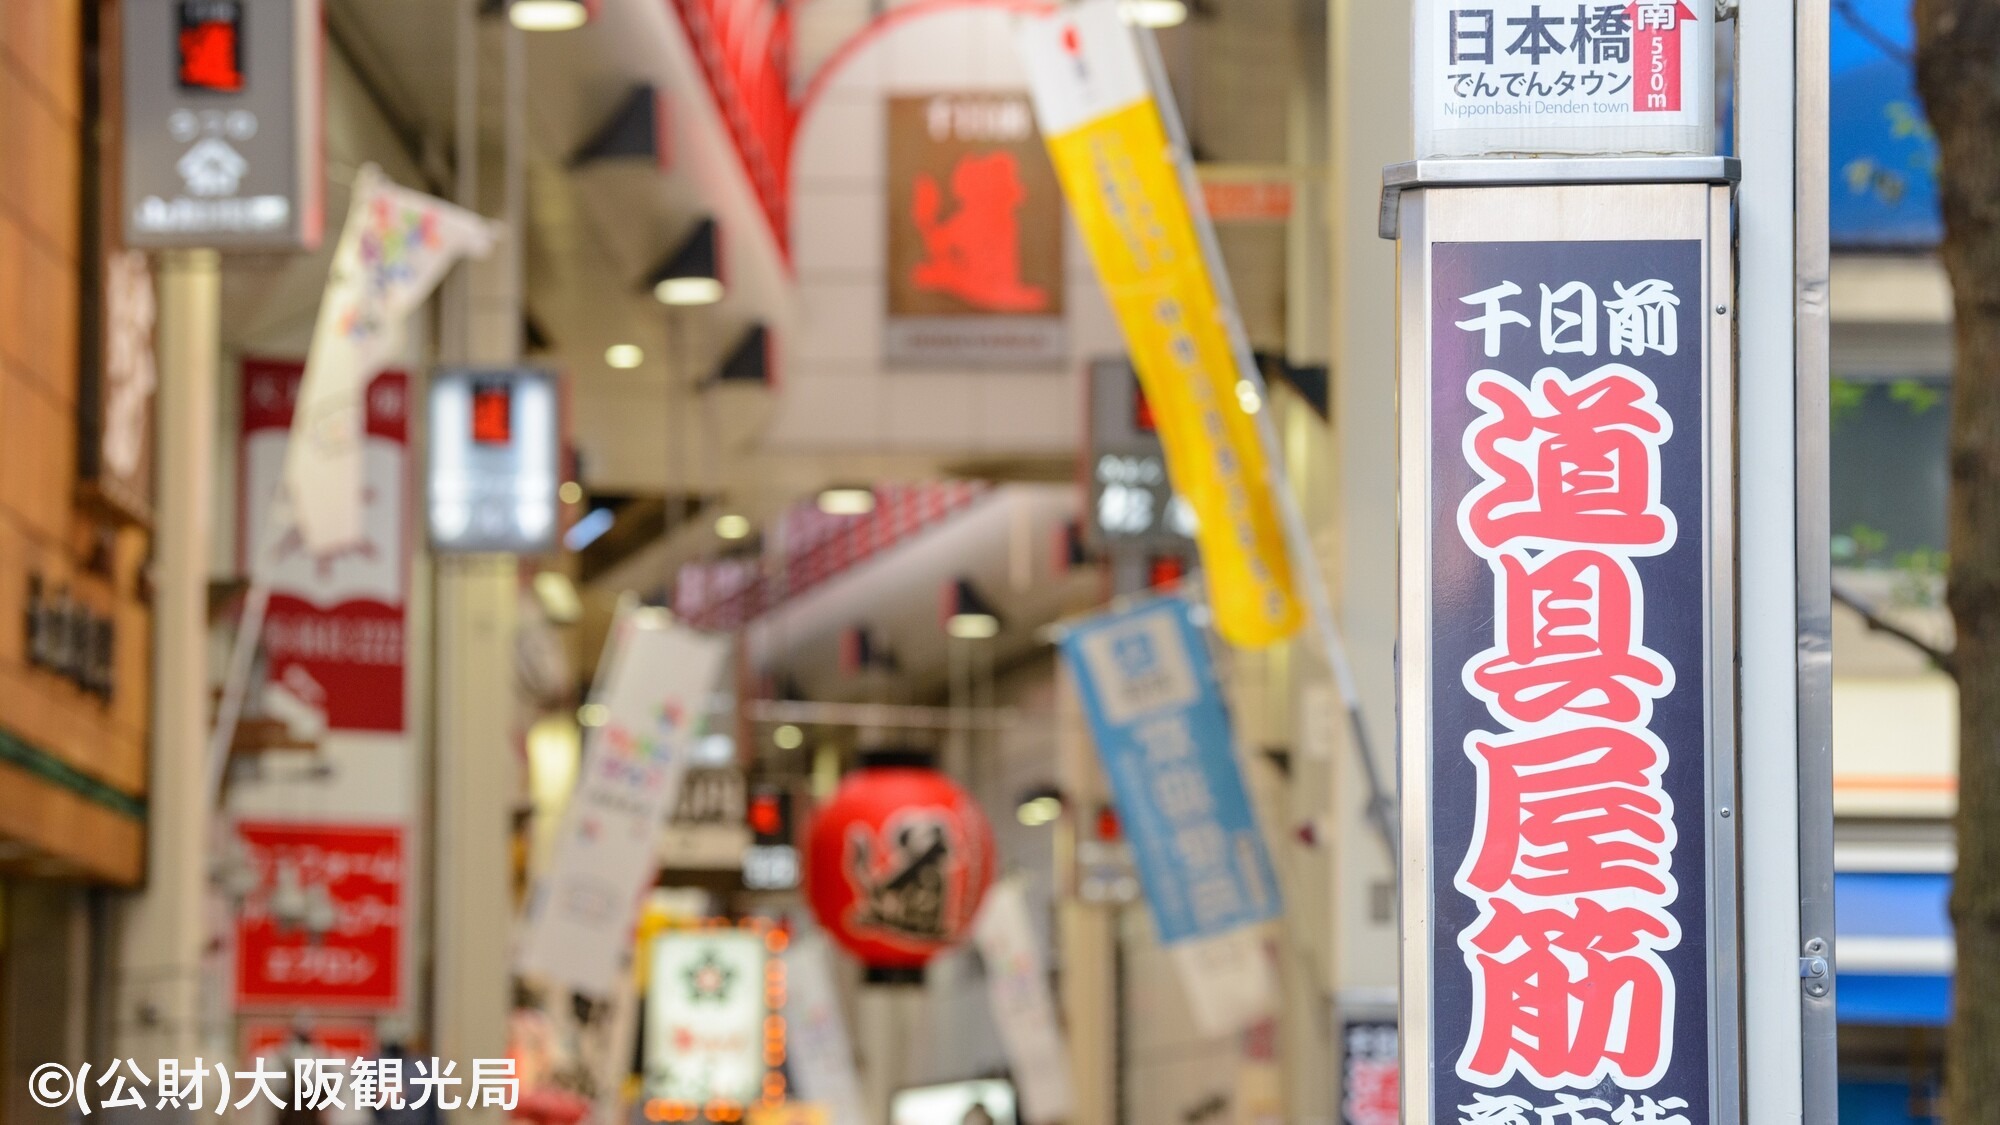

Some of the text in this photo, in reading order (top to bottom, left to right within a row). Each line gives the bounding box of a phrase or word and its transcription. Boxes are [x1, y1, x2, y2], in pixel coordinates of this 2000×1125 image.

[1449, 4, 1632, 66] 日本橋
[1443, 100, 1630, 118] Nipponbashi Denden town
[1447, 69, 1632, 98] でんでんタウン
[1454, 278, 1682, 358] 千日前
[1455, 363, 1682, 1090] 道具屋筋
